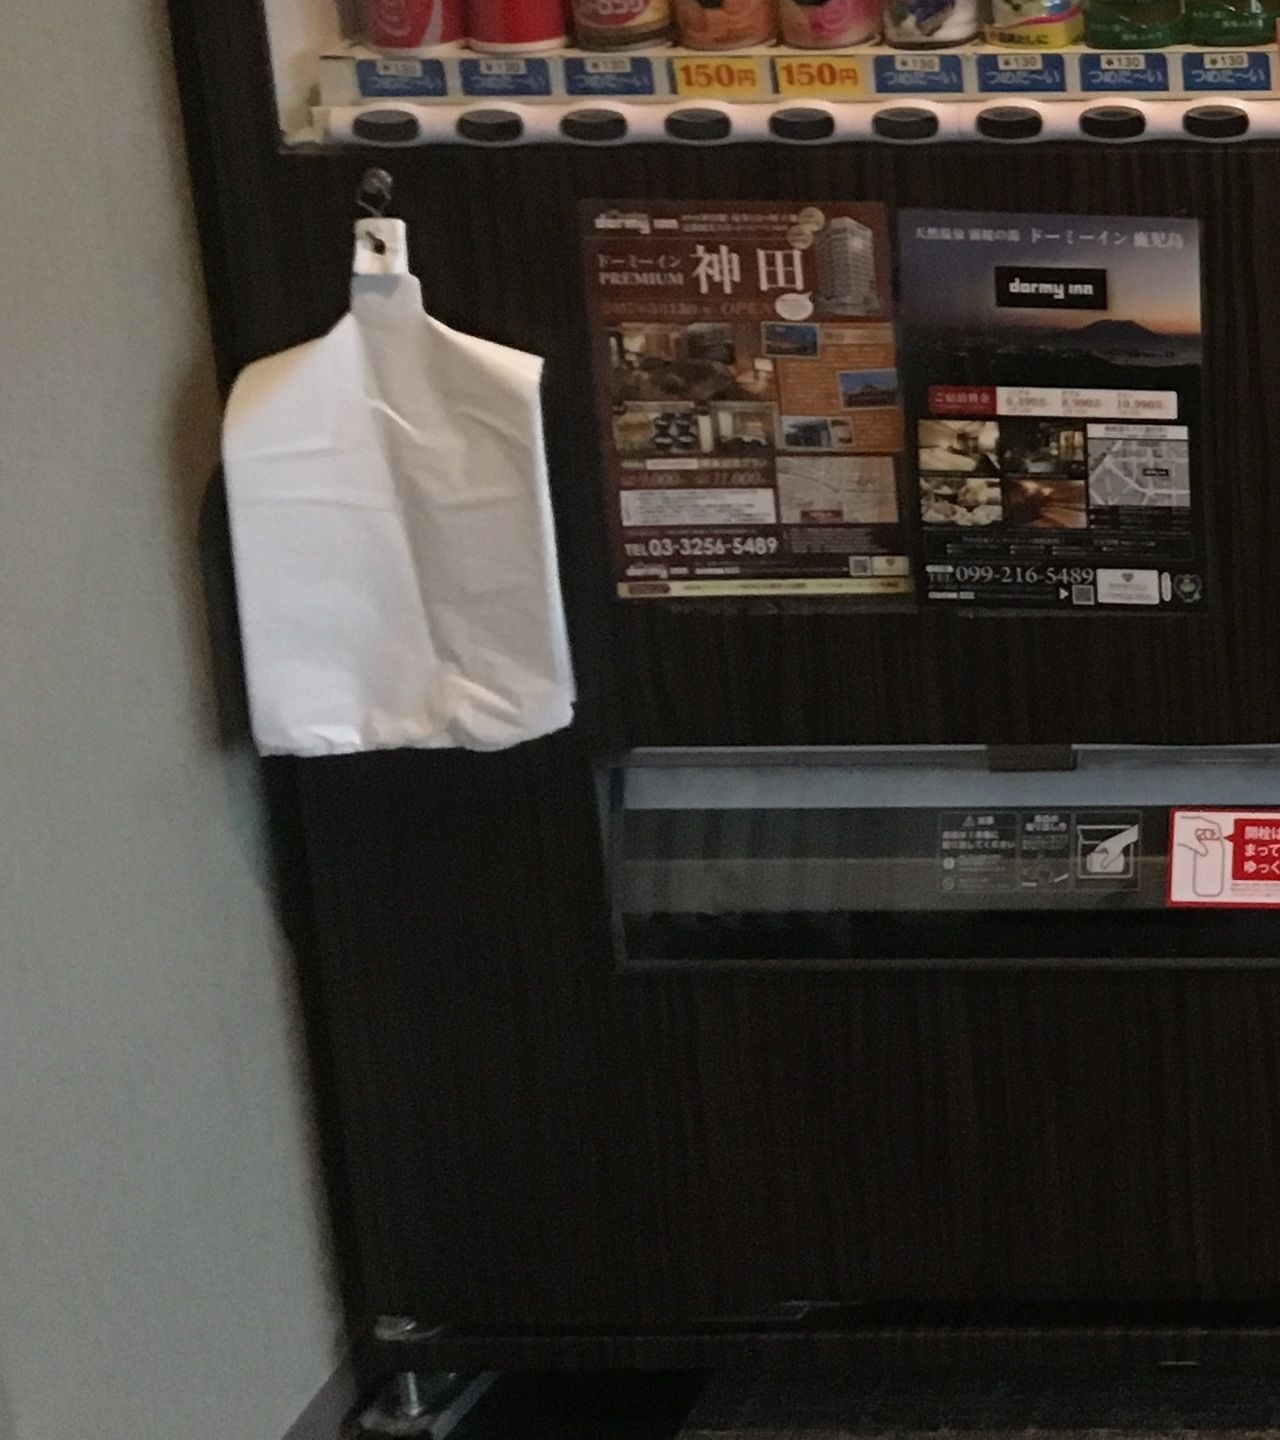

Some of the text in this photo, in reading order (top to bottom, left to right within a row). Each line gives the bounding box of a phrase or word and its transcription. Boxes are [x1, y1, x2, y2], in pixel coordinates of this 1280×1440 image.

[680, 63, 757, 87] 150円
[780, 63, 860, 87] 150円
[689, 243, 805, 296] 神田
[1008, 277, 1094, 299] dormy inn
[648, 537, 779, 557] 03-3256-5489
[955, 564, 1094, 585] 099-216-5489
